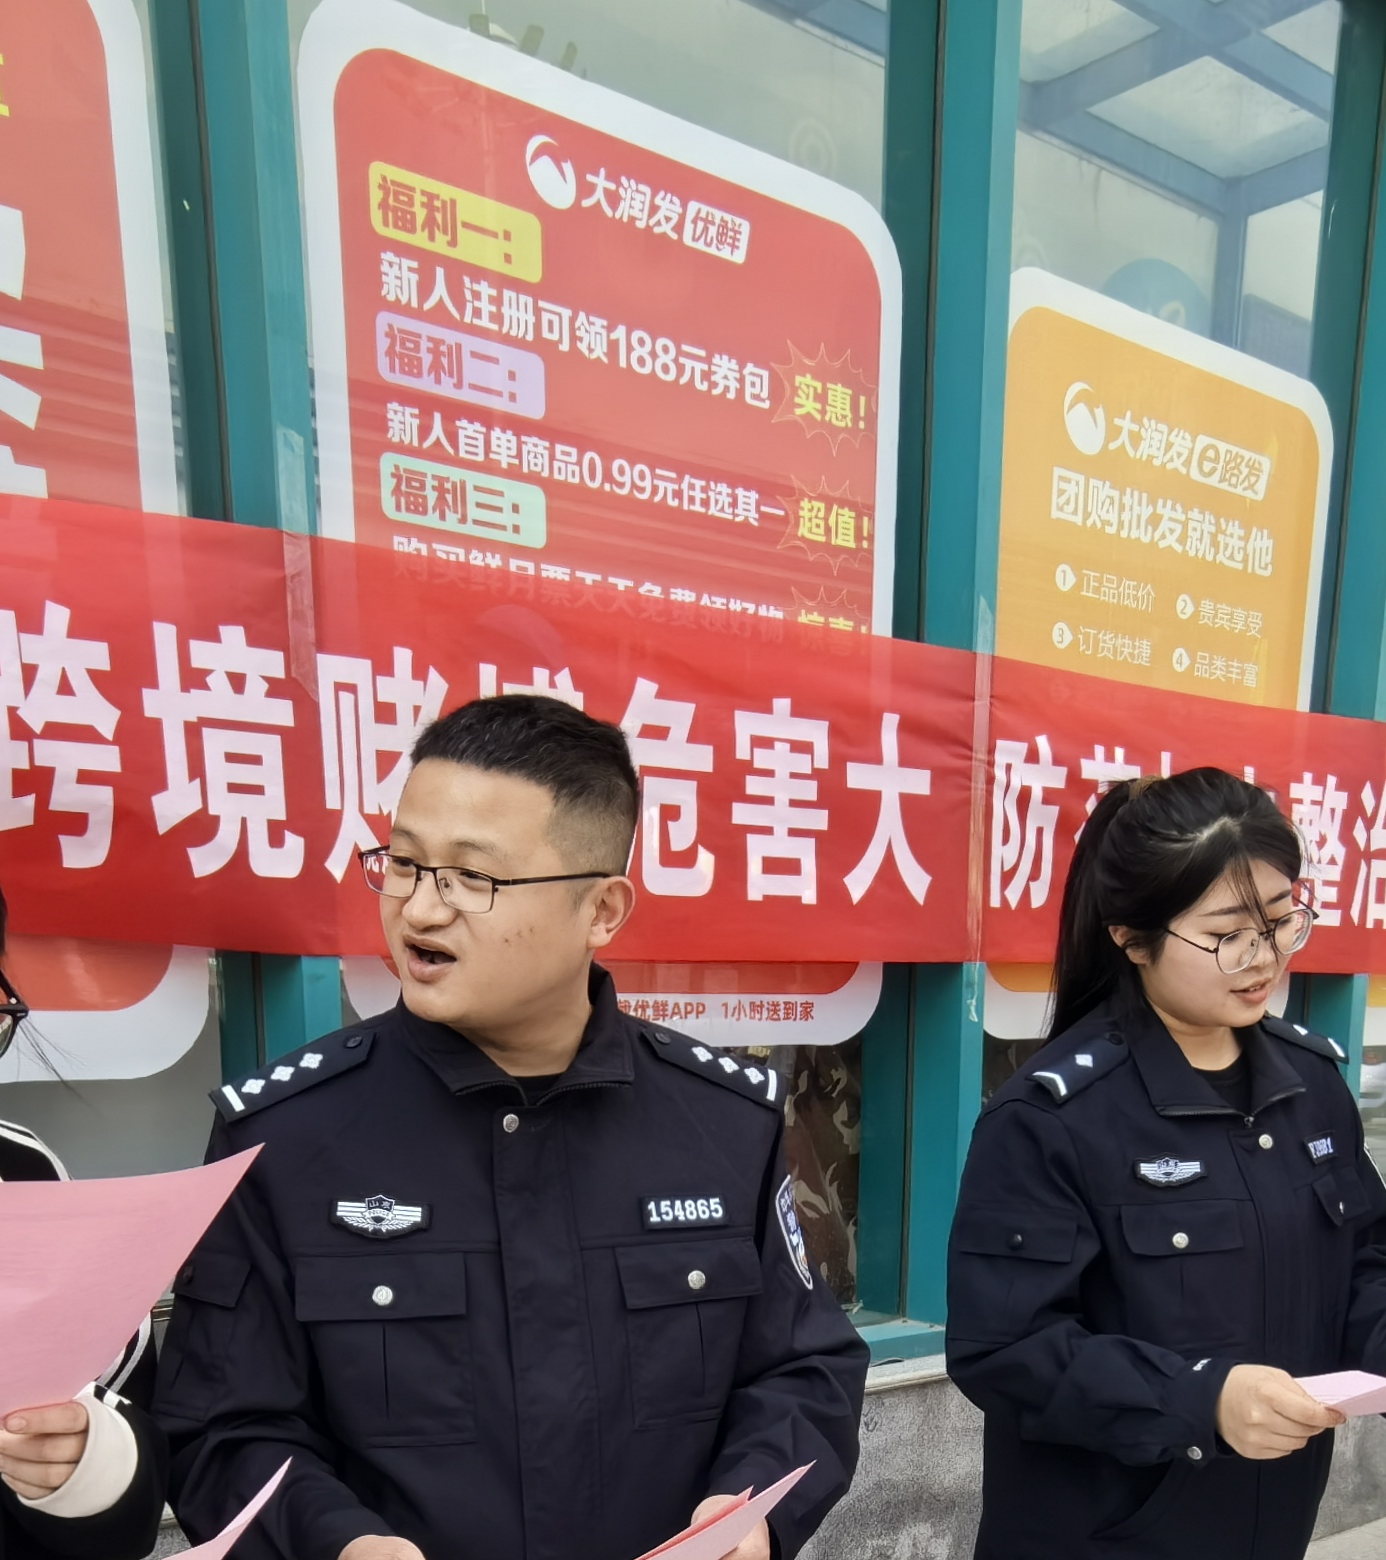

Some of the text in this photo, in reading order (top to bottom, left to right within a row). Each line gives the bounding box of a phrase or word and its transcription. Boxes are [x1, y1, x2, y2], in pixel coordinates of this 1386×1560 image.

[379, 251, 772, 410] 新人注册可领188元券包
[386, 402, 785, 528] 新人首单商品0.99元任选其一
[1050, 467, 1274, 578] 团购批发就选他
[1080, 569, 1155, 613] 正品低价
[1198, 599, 1263, 638] 贵宾享受
[1077, 625, 1152, 667] 订货快捷
[1193, 652, 1259, 688] 品类丰富
[722, 1000, 815, 1022] 1小时送到家
[647, 1198, 724, 1222] 154865
